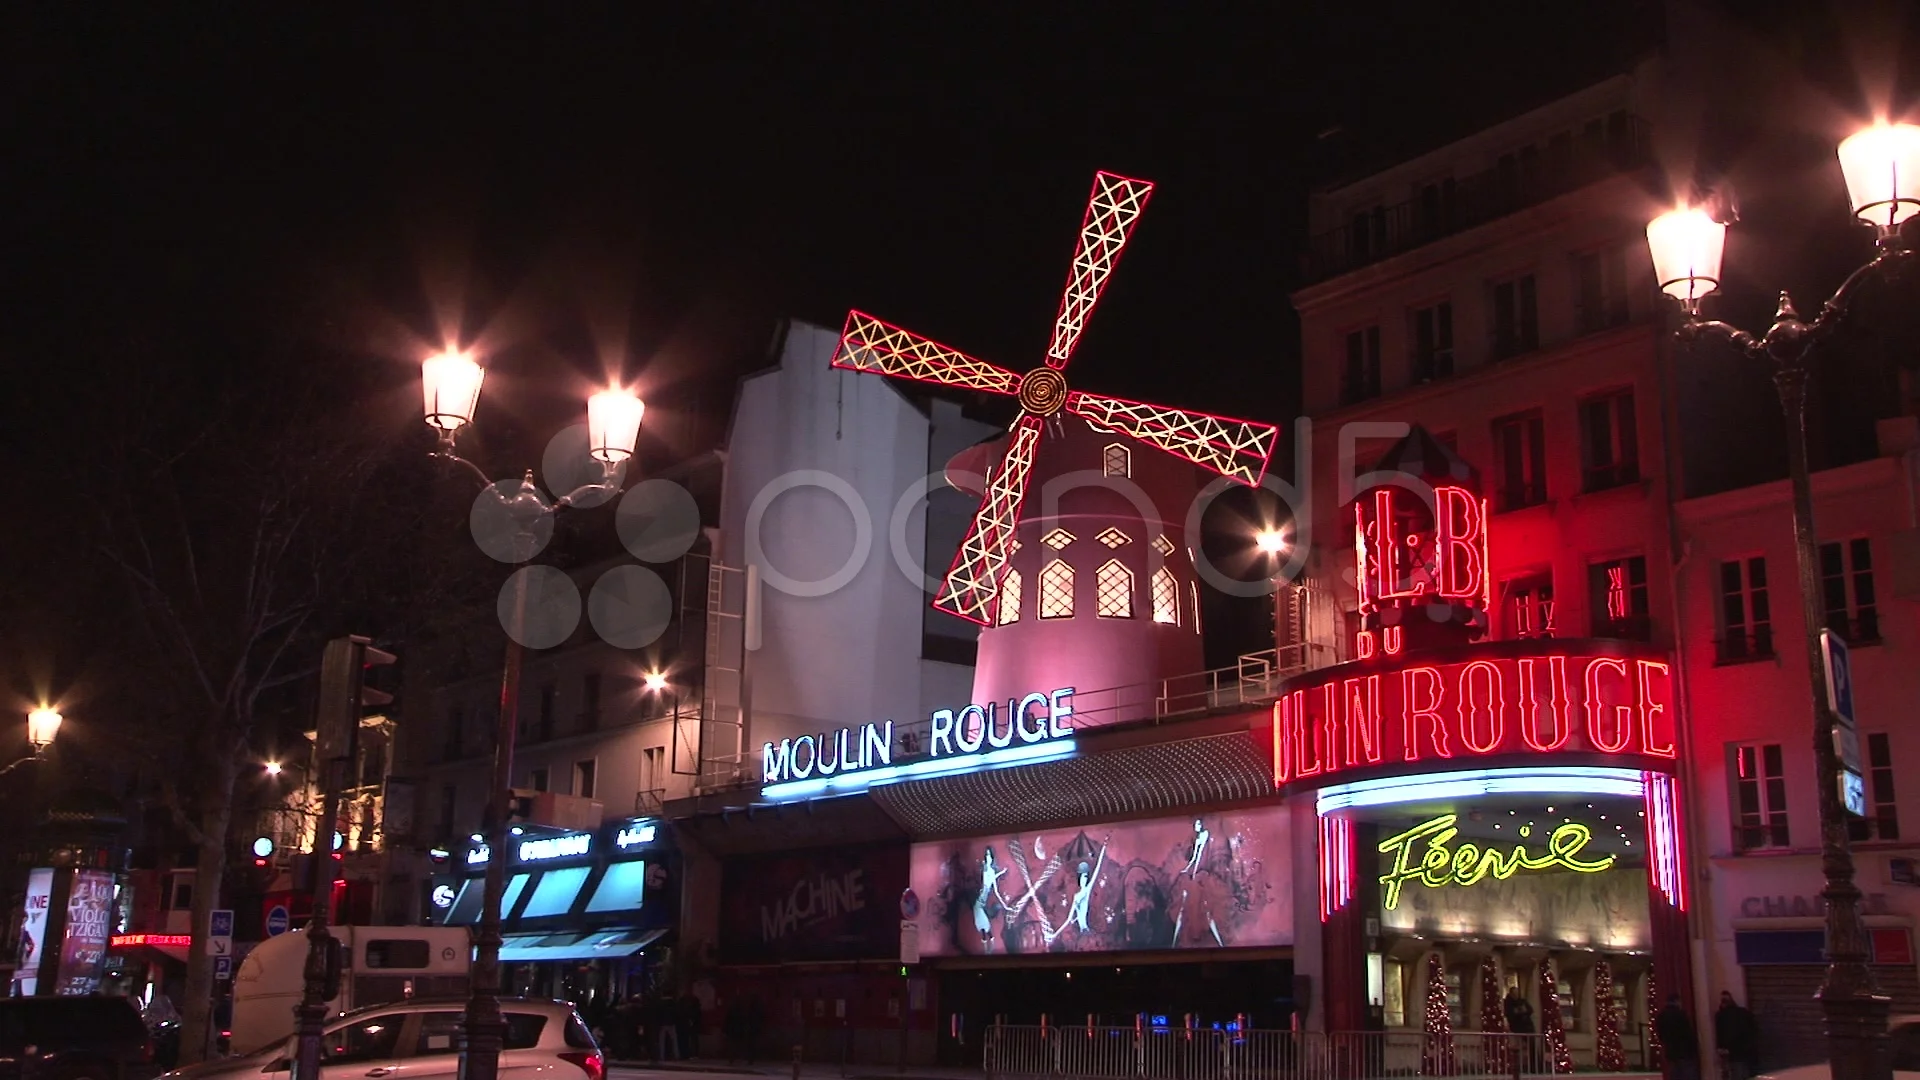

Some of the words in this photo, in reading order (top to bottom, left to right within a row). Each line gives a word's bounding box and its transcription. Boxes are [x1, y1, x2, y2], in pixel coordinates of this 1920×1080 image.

[1357, 626, 1402, 660] DU
[763, 720, 894, 783] MOULIN
[930, 687, 1077, 757] ROUGE
[1402, 656, 1676, 761] ROUGE
[760, 868, 866, 944] MACHINE
[1378, 814, 1617, 910] Féerie
